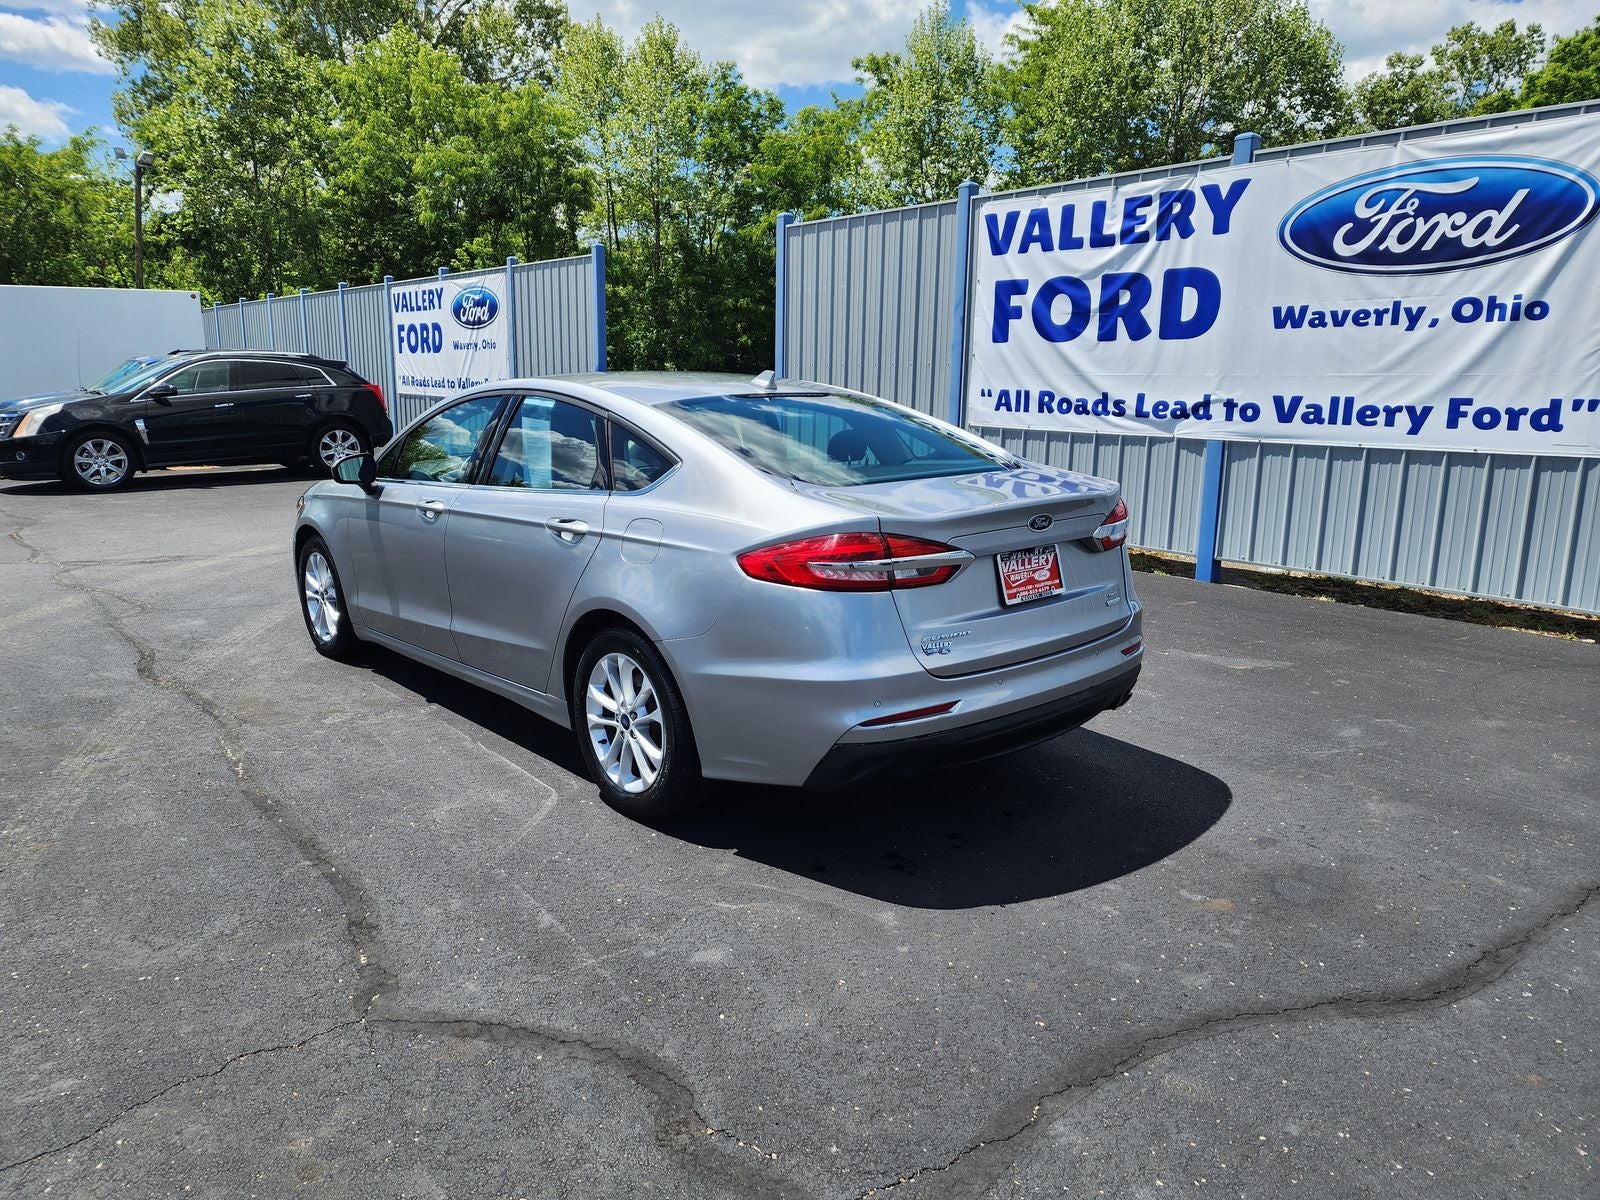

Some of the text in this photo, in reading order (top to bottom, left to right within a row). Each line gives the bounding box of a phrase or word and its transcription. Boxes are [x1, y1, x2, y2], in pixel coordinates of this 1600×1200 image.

[985, 178, 1252, 256] VALLERY
[1333, 176, 1530, 257] Ford
[393, 287, 444, 313] VALLERY
[460, 293, 490, 321] Ford
[992, 267, 1222, 343] FORD
[1272, 294, 1550, 332] Waverly, Ohio
[397, 322, 443, 354] FORD
[482, 339, 497, 350] Ohio
[411, 376, 429, 388] Roads
[431, 377, 446, 389] Lead
[447, 378, 456, 389] to
[980, 388, 1030, 413] "All
[1038, 390, 1127, 418] Roads
[1135, 392, 1213, 420] Lead
[1223, 394, 1261, 422] to
[1272, 395, 1434, 436] Vallery
[1001, 553, 1054, 573] VALLERY
[921, 640, 953, 650] VALLERY
